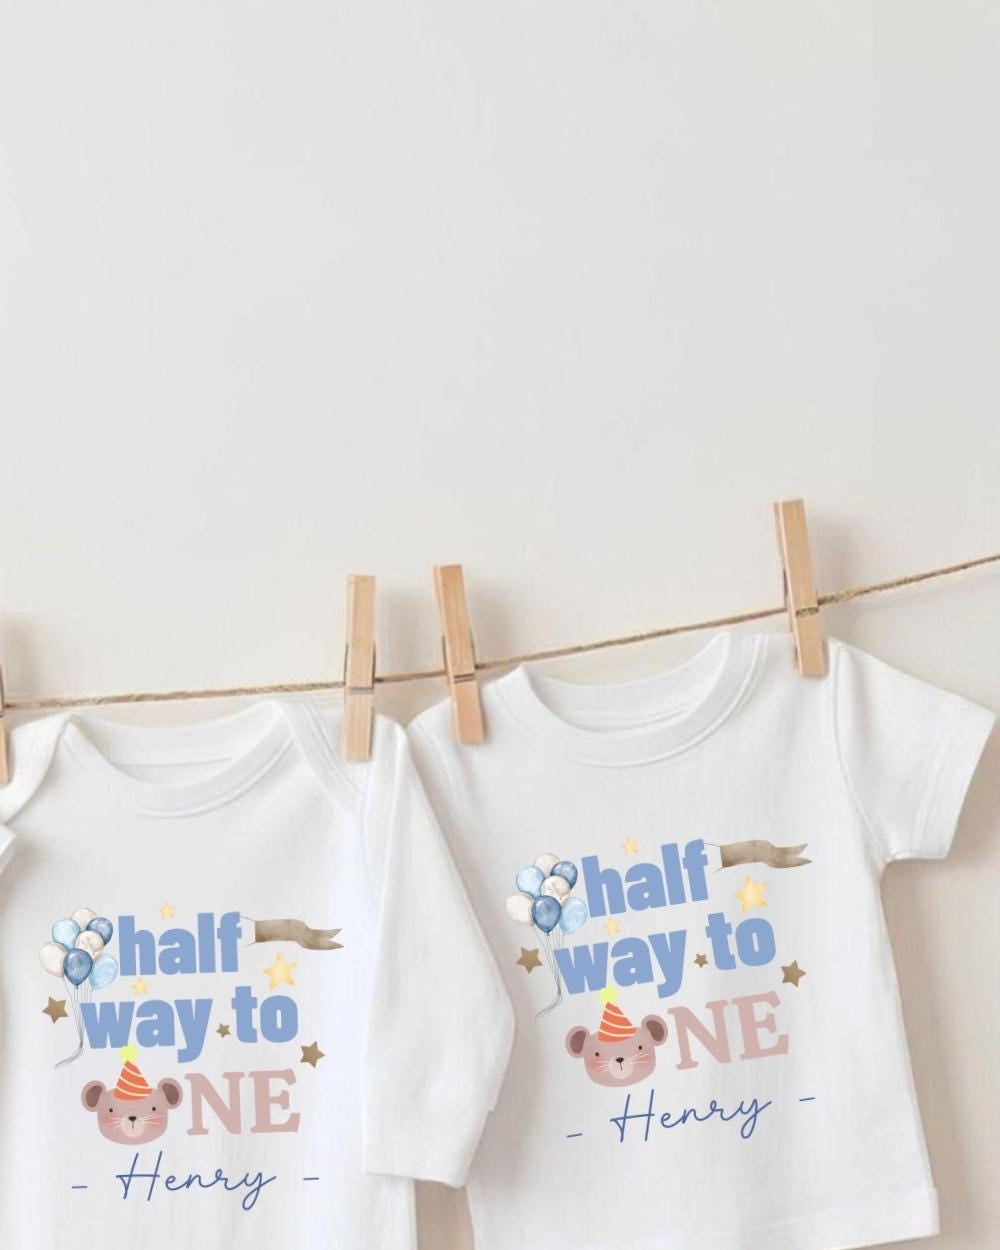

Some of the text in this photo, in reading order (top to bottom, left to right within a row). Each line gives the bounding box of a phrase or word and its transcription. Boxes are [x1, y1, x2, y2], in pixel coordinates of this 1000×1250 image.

[581, 838, 710, 918] half
[117, 911, 243, 977] half
[553, 911, 777, 999] way to
[80, 985, 299, 1064] way to
[609, 1088, 773, 1143] Henry
[115, 1150, 278, 1211] Henry
